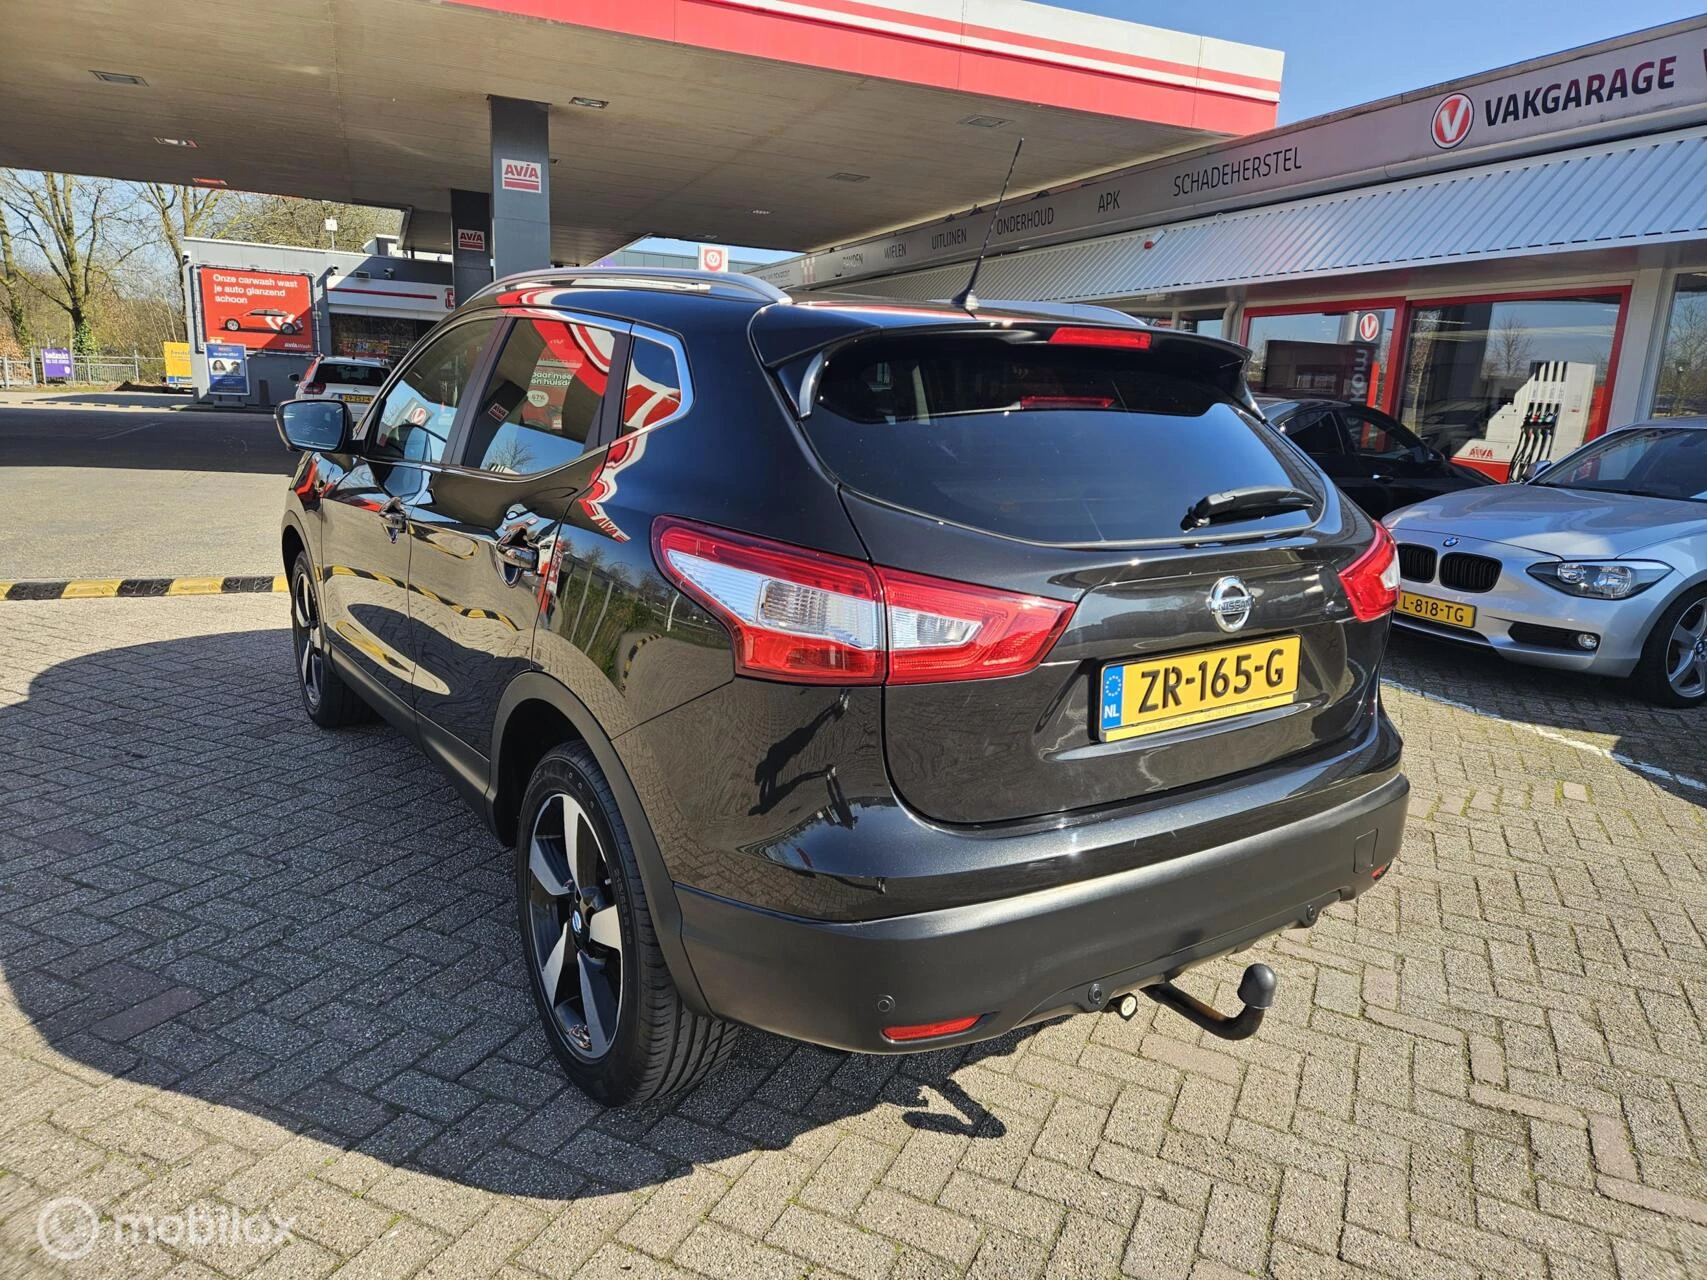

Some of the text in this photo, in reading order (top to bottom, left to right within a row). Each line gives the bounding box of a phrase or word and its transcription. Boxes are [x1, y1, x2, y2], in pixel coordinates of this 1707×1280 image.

[1484, 55, 1677, 127] VAKGARAGE
[1172, 145, 1303, 198] SCHADEHERSTEL
[1097, 190, 1121, 213] APK
[996, 206, 1055, 236] ONDERHOUD
[883, 243, 907, 260] WIELEN
[213, 273, 299, 289] Onze carwash wast
[214, 283, 286, 297] je auto glanzend
[215, 295, 248, 304] schoon
[1218, 597, 1252, 611] NISSAN
[1402, 595, 1464, 622] L-818-TG
[1138, 647, 1284, 714] ZR-165-G
[1104, 704, 1120, 719] NL
